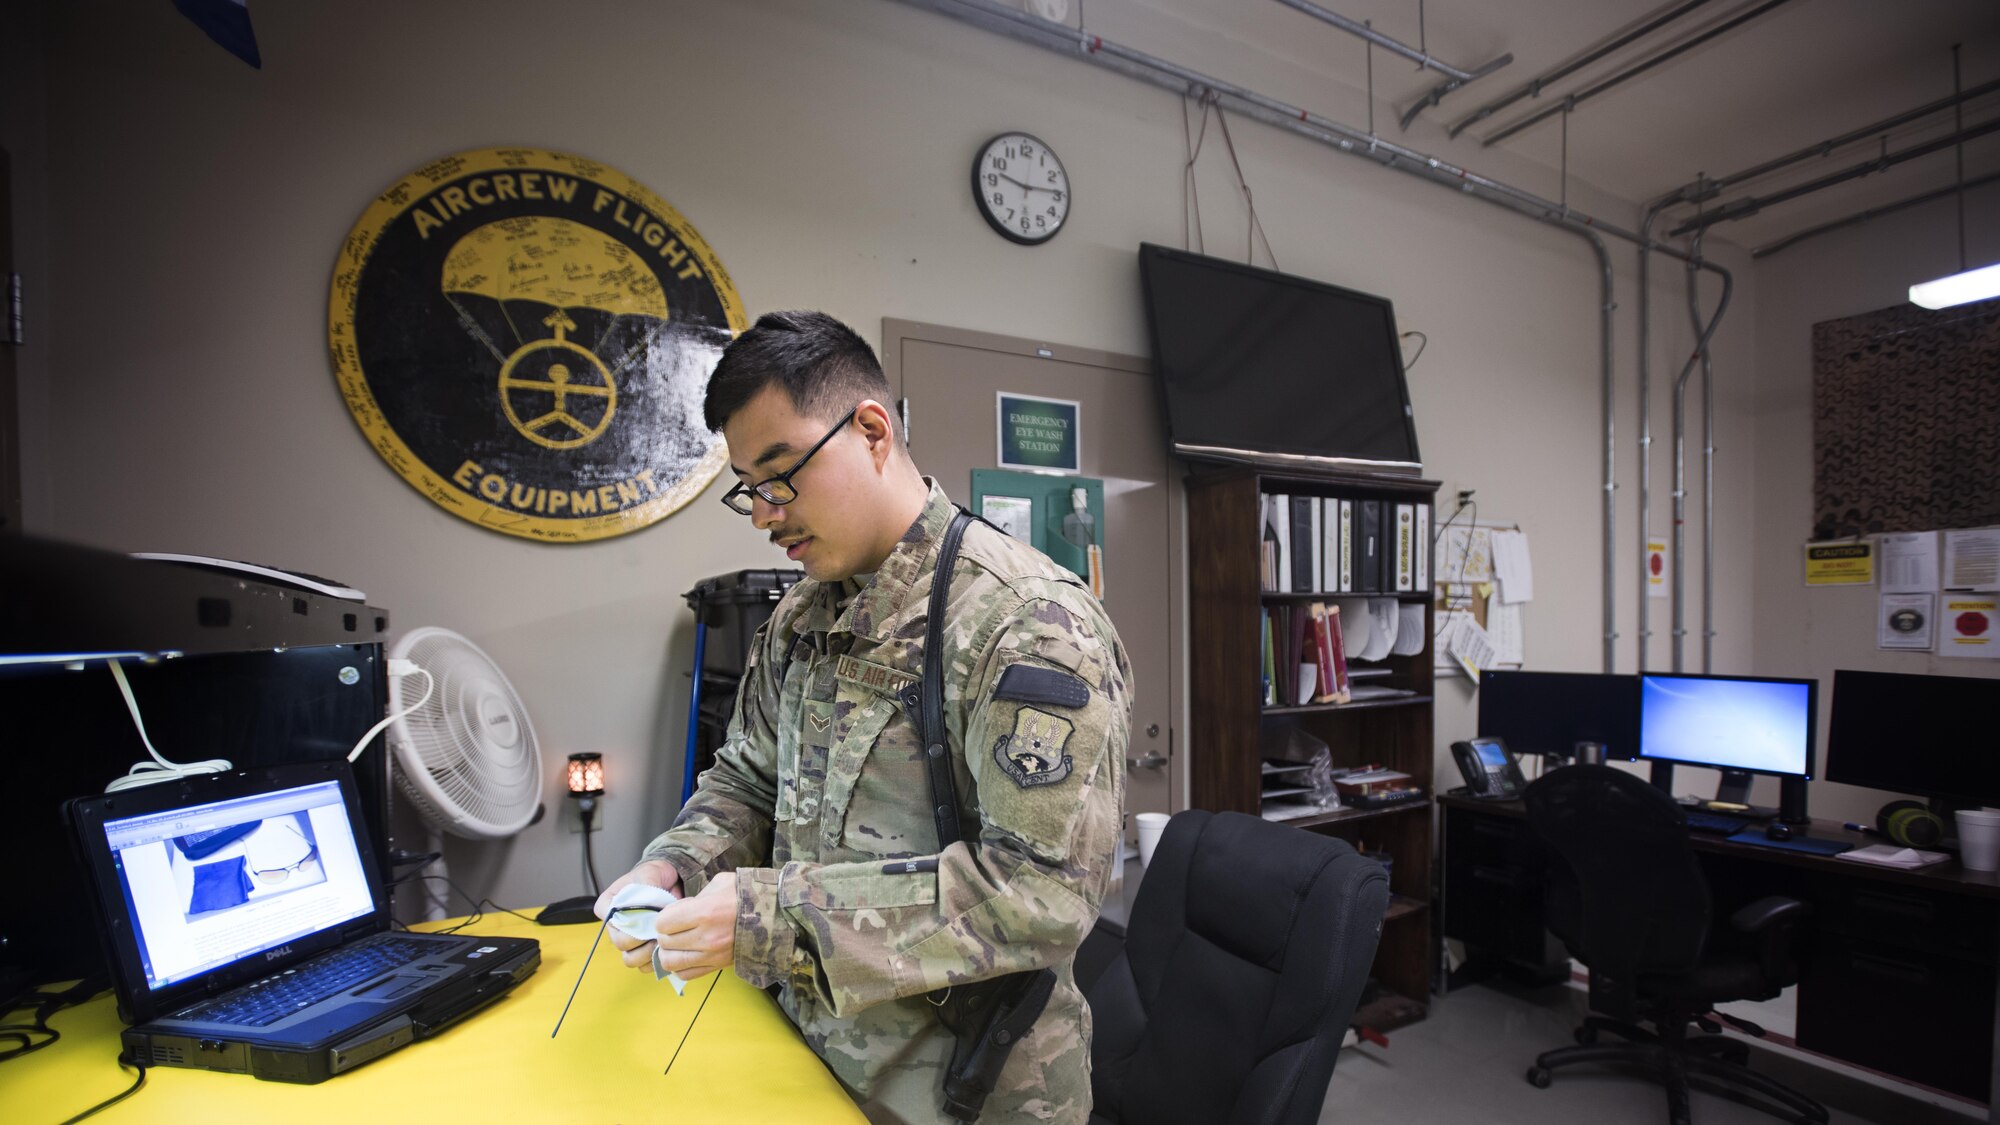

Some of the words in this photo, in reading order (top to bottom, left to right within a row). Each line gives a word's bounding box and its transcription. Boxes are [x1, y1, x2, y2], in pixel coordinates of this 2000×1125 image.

[1005, 145, 1016, 160] 11
[1020, 144, 1033, 159] 12
[993, 156, 1007, 171] 10
[1040, 154, 1045, 168] 1
[987, 173, 998, 187] 9
[1047, 170, 1057, 184] 2
[993, 192, 1004, 206] 8
[1052, 189, 1062, 202] 3
[1006, 207, 1016, 221] 7
[1047, 206, 1056, 217] 4
[411, 173, 579, 240] AIRCREW
[593, 188, 703, 281] FLIGHT
[1020, 216, 1031, 230] 6
[1036, 214, 1046, 228] 5
[1010, 413, 1068, 428] EMERGENCY
[1016, 427, 1034, 437] EYE
[1035, 429, 1063, 440] WASH
[1019, 439, 1060, 452] STATION
[452, 458, 657, 516] EQUIPMENT
[861, 665, 887, 688] AIR
[887, 672, 914, 692] FO
[265, 946, 293, 962] DELL
